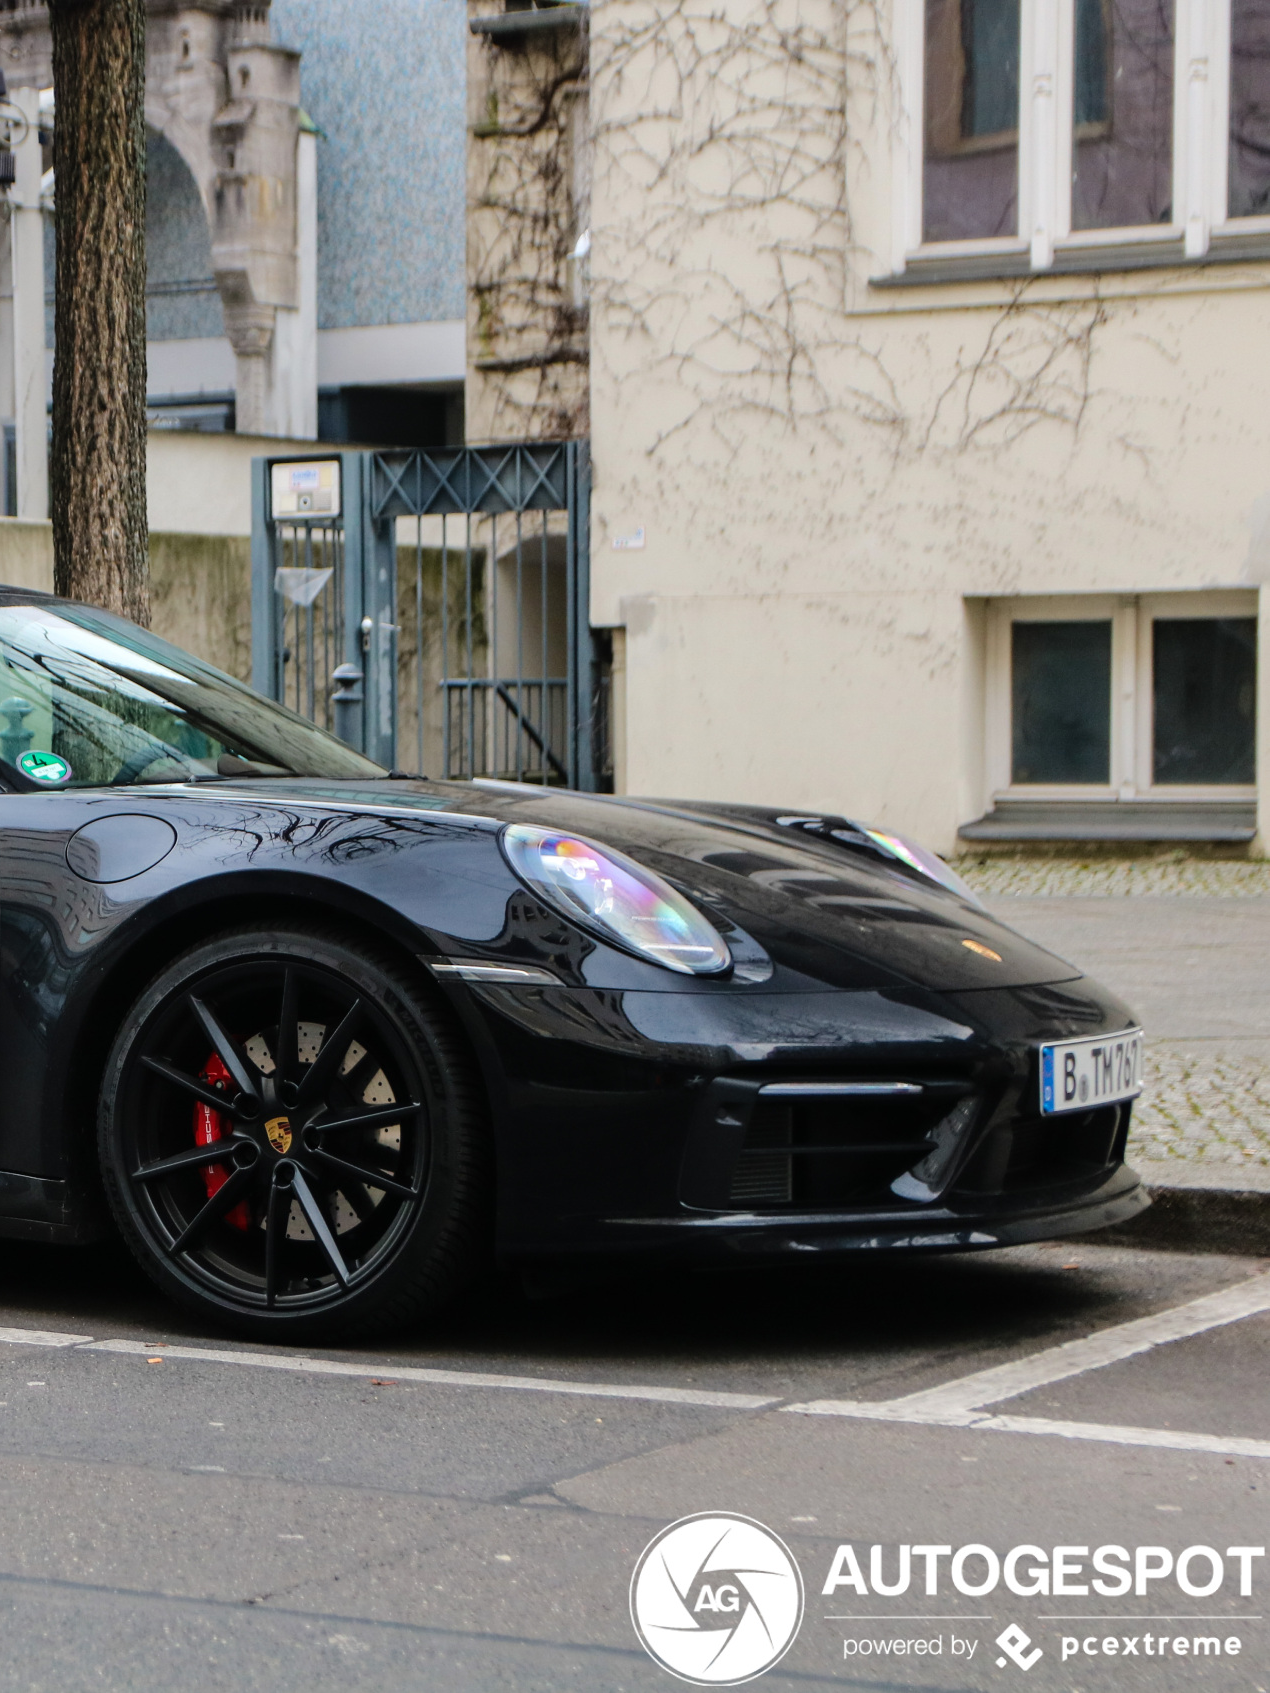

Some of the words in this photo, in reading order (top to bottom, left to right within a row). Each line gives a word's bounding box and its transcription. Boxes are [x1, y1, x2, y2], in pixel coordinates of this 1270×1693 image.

[32, 754, 47, 766] 4
[1064, 1052, 1077, 1101] B
[1091, 1046, 1114, 1097] TM
[204, 1104, 215, 1174] PSCHE
